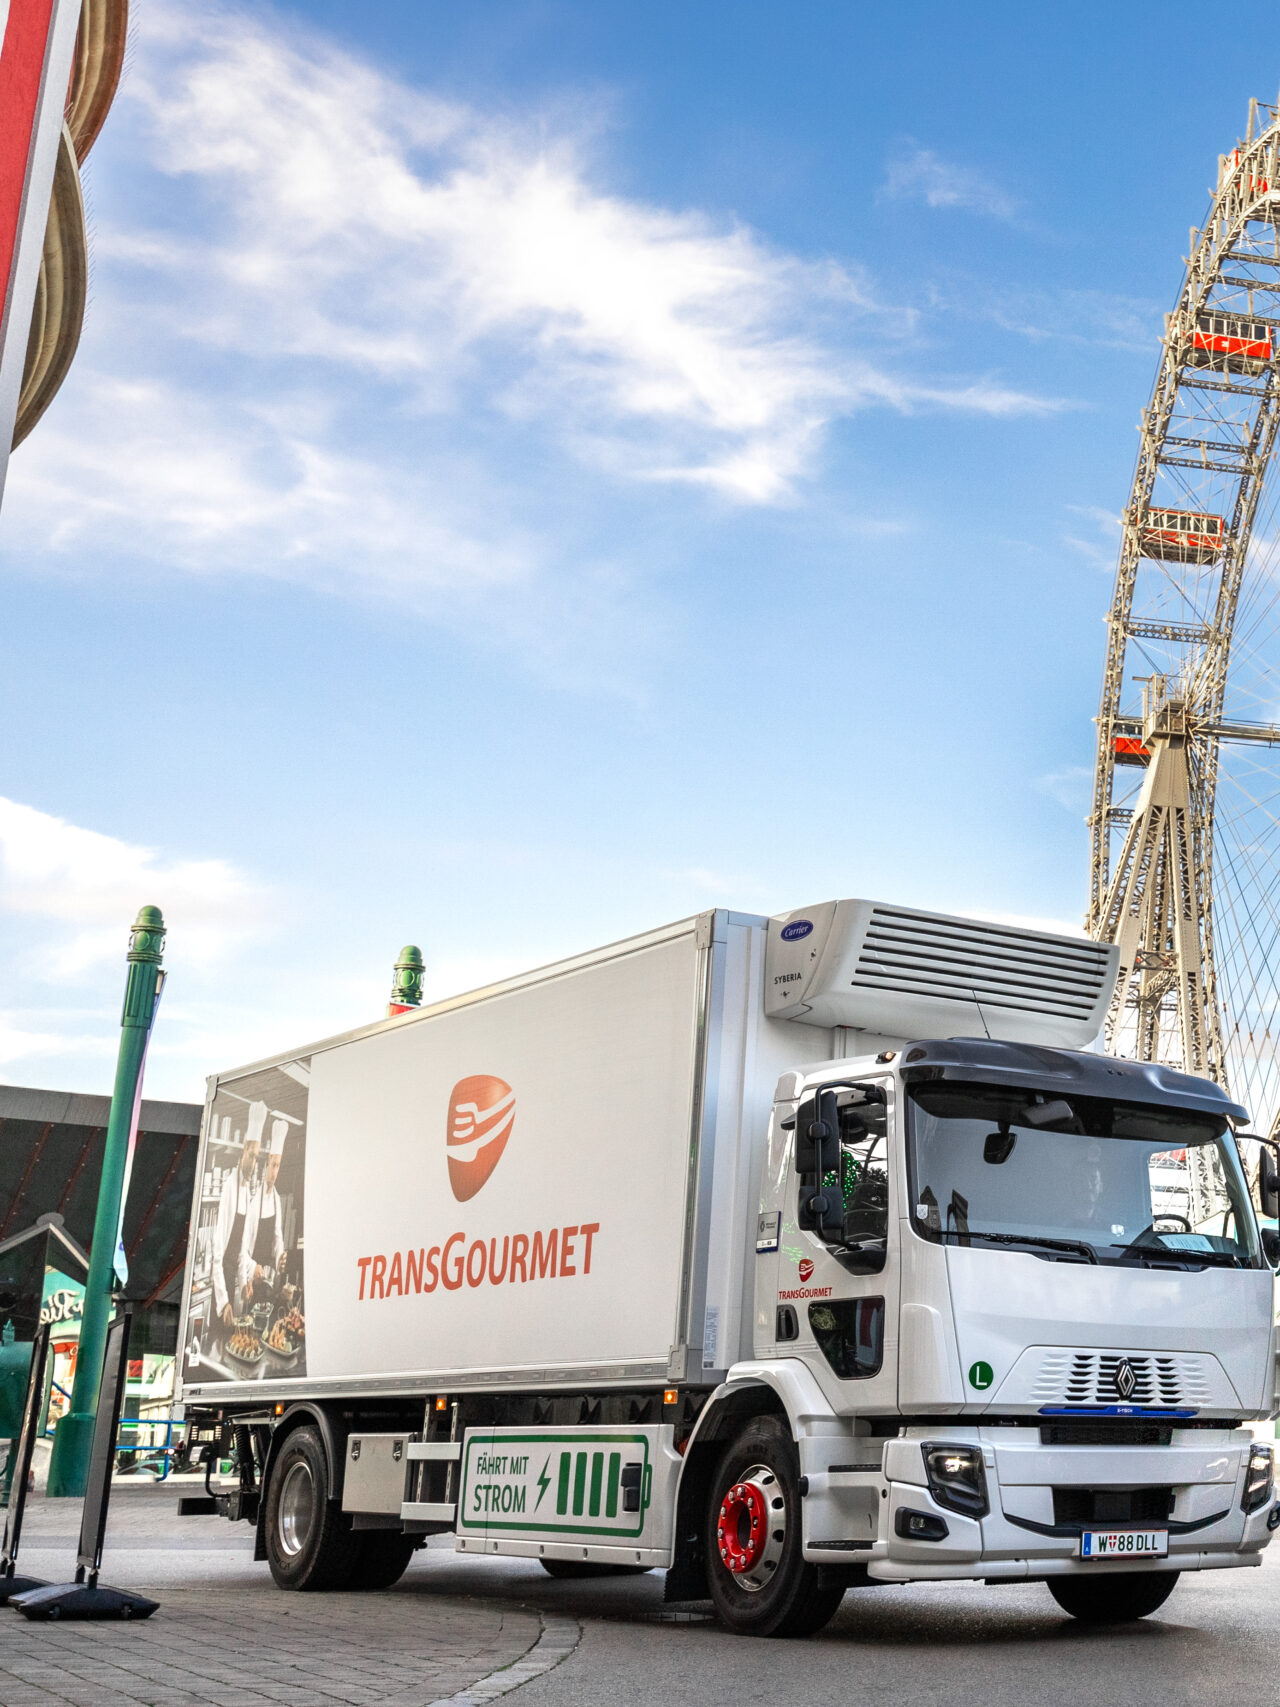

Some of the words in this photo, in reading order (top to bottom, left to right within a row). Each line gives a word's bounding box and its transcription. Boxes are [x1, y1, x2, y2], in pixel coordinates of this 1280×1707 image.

[784, 925, 809, 938] Carrier
[774, 972, 802, 985] SYBERIA
[357, 1222, 600, 1300] TRANSGOURMET
[778, 1286, 833, 1300] TRANSGOURMET
[976, 1365, 988, 1386] L
[477, 1452, 508, 1475] FÄHRT
[509, 1456, 529, 1475] MIT
[473, 1484, 526, 1513] STROM
